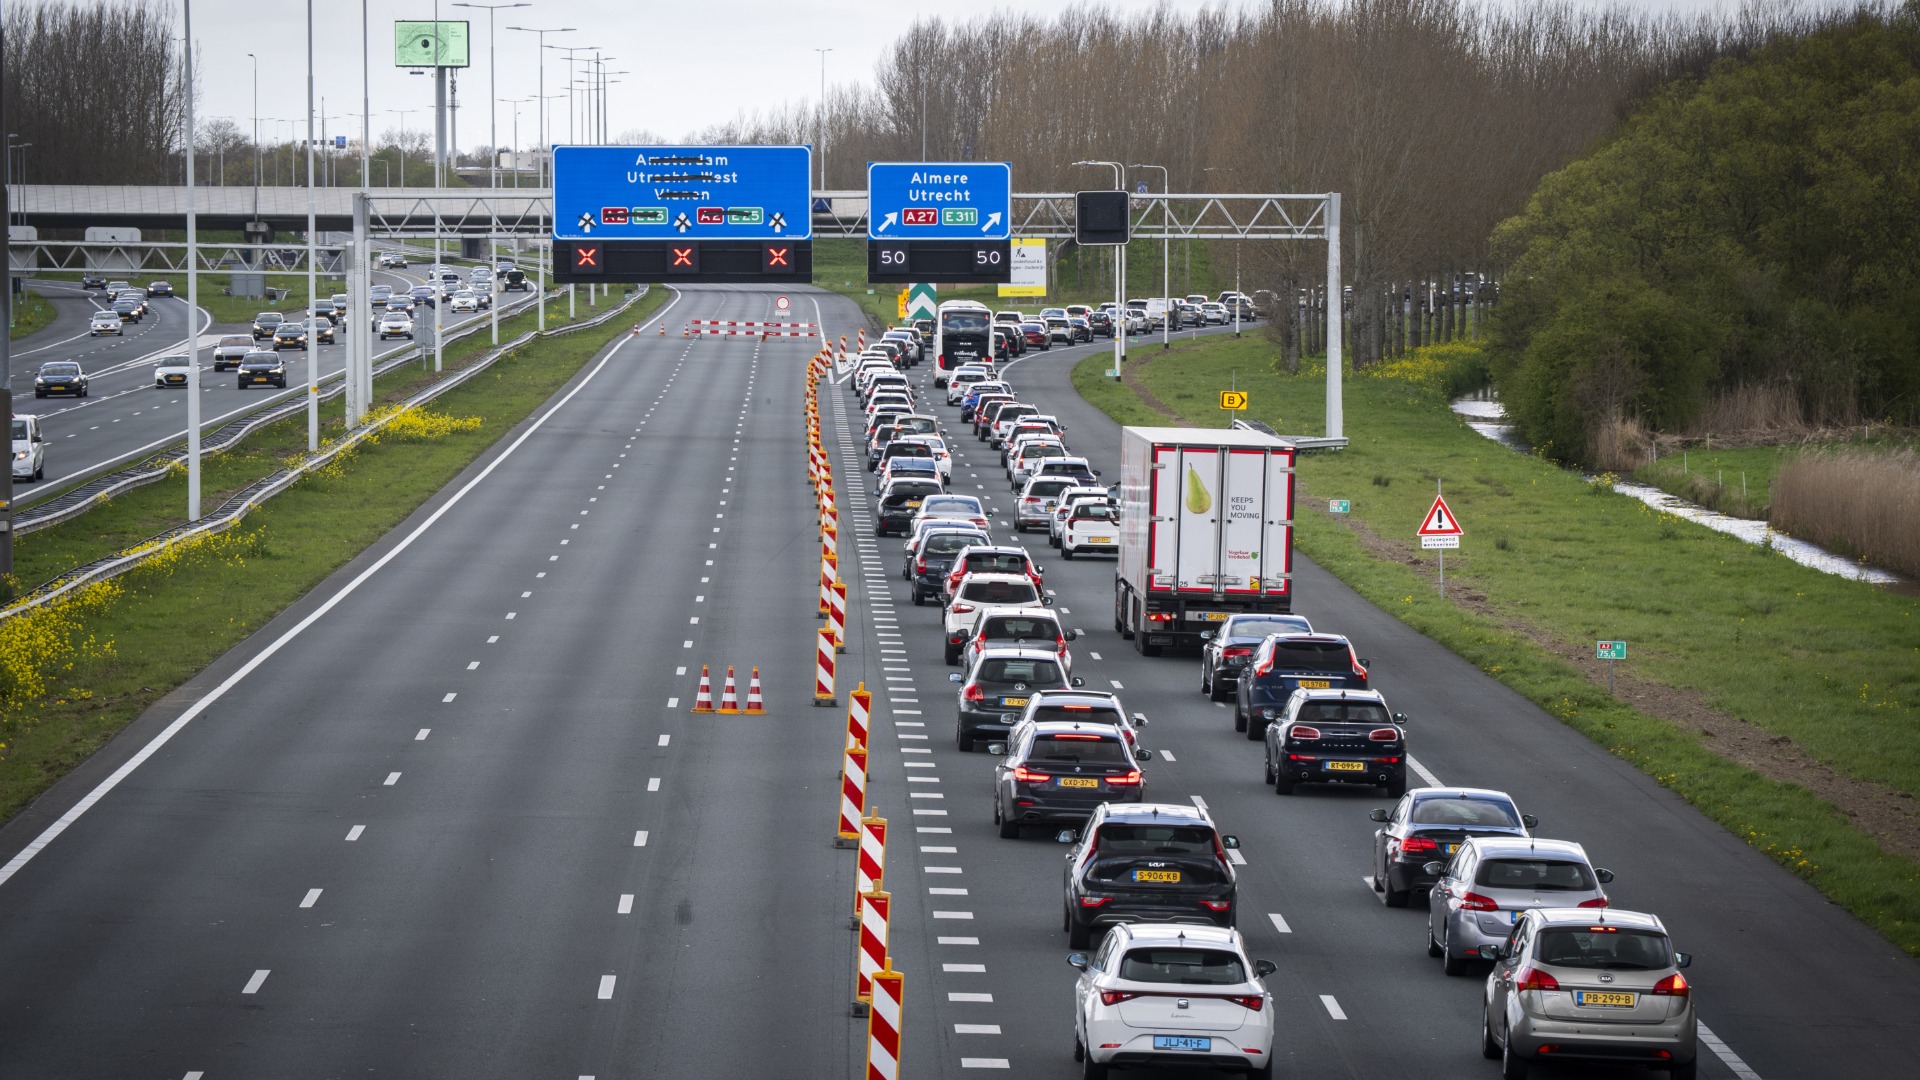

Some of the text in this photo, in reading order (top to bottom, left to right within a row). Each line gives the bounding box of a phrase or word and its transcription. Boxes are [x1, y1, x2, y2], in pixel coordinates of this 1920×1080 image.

[910, 172, 968, 185] Almere
[909, 189, 971, 202] Utrecht
[881, 250, 906, 264] 50
[976, 250, 1001, 264] 50
[1227, 395, 1235, 405] B
[1231, 496, 1254, 504] KEEPS
[1230, 511, 1260, 519] MOVING
[1179, 580, 1189, 588] 25
[1599, 650, 1616, 658] 75,6
[1330, 762, 1362, 770] RT-095-P
[1063, 779, 1096, 787] GXD-37-L
[1138, 871, 1178, 881] S-906-KB
[1585, 994, 1632, 1004] PB-299-B
[1162, 1038, 1203, 1048] JLJ-41-F
